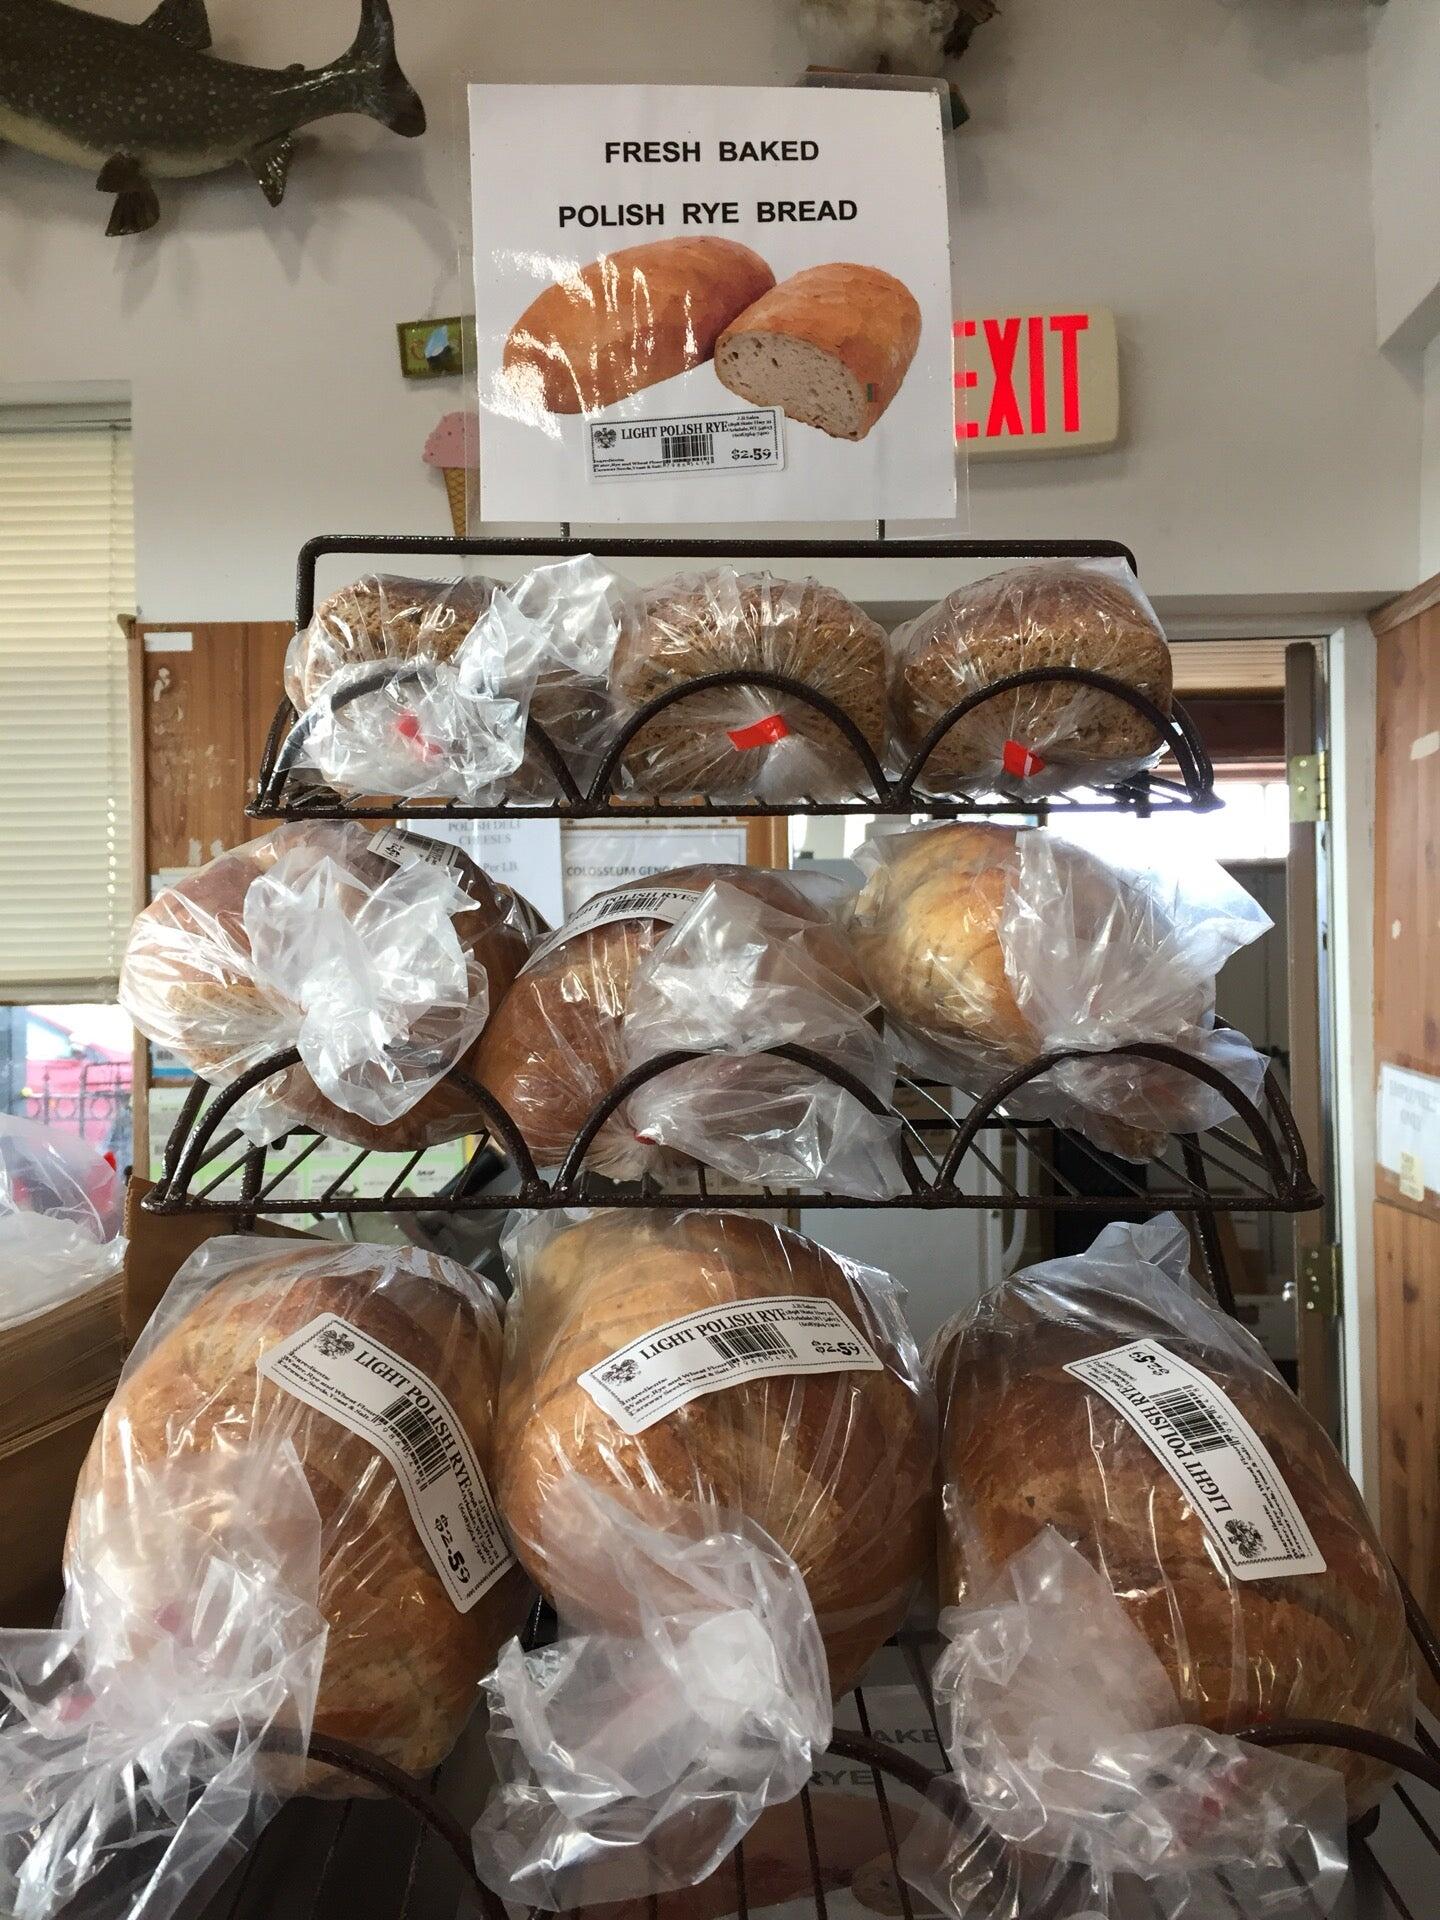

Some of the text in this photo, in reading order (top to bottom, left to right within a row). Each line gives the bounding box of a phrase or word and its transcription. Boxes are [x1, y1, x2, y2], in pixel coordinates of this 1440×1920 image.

[605, 140, 819, 164] FRESH BAKED
[558, 199, 858, 228] POLISH RYE BREAD
[953, 315, 1089, 438] EXIT
[621, 427, 658, 440] LIGHT
[660, 423, 703, 437] POLISH
[706, 421, 729, 433] RYE
[731, 448, 772, 461] $2.59
[458, 834, 511, 844] CHESES
[567, 866, 636, 876] COLOSSEUM
[604, 891, 657, 904] POLISH
[661, 891, 689, 902] RYE
[639, 1308, 788, 1360] LIGHT POLISH RYE
[812, 1339, 860, 1355] $2.59
[1130, 1351, 1170, 1376] $2.59
[666, 1376, 681, 1386] and
[681, 1367, 706, 1378] Wheat
[320, 1380, 334, 1390] and
[334, 1389, 356, 1404] Wheat
[354, 1350, 473, 1492] LIGHT POLISH RYE
[1121, 1385, 1233, 1513] LIGHT POLISH RYE
[1246, 1465, 1264, 1492] Wheat
[1262, 1492, 1274, 1509] and
[435, 1514, 470, 1584] $2.59
